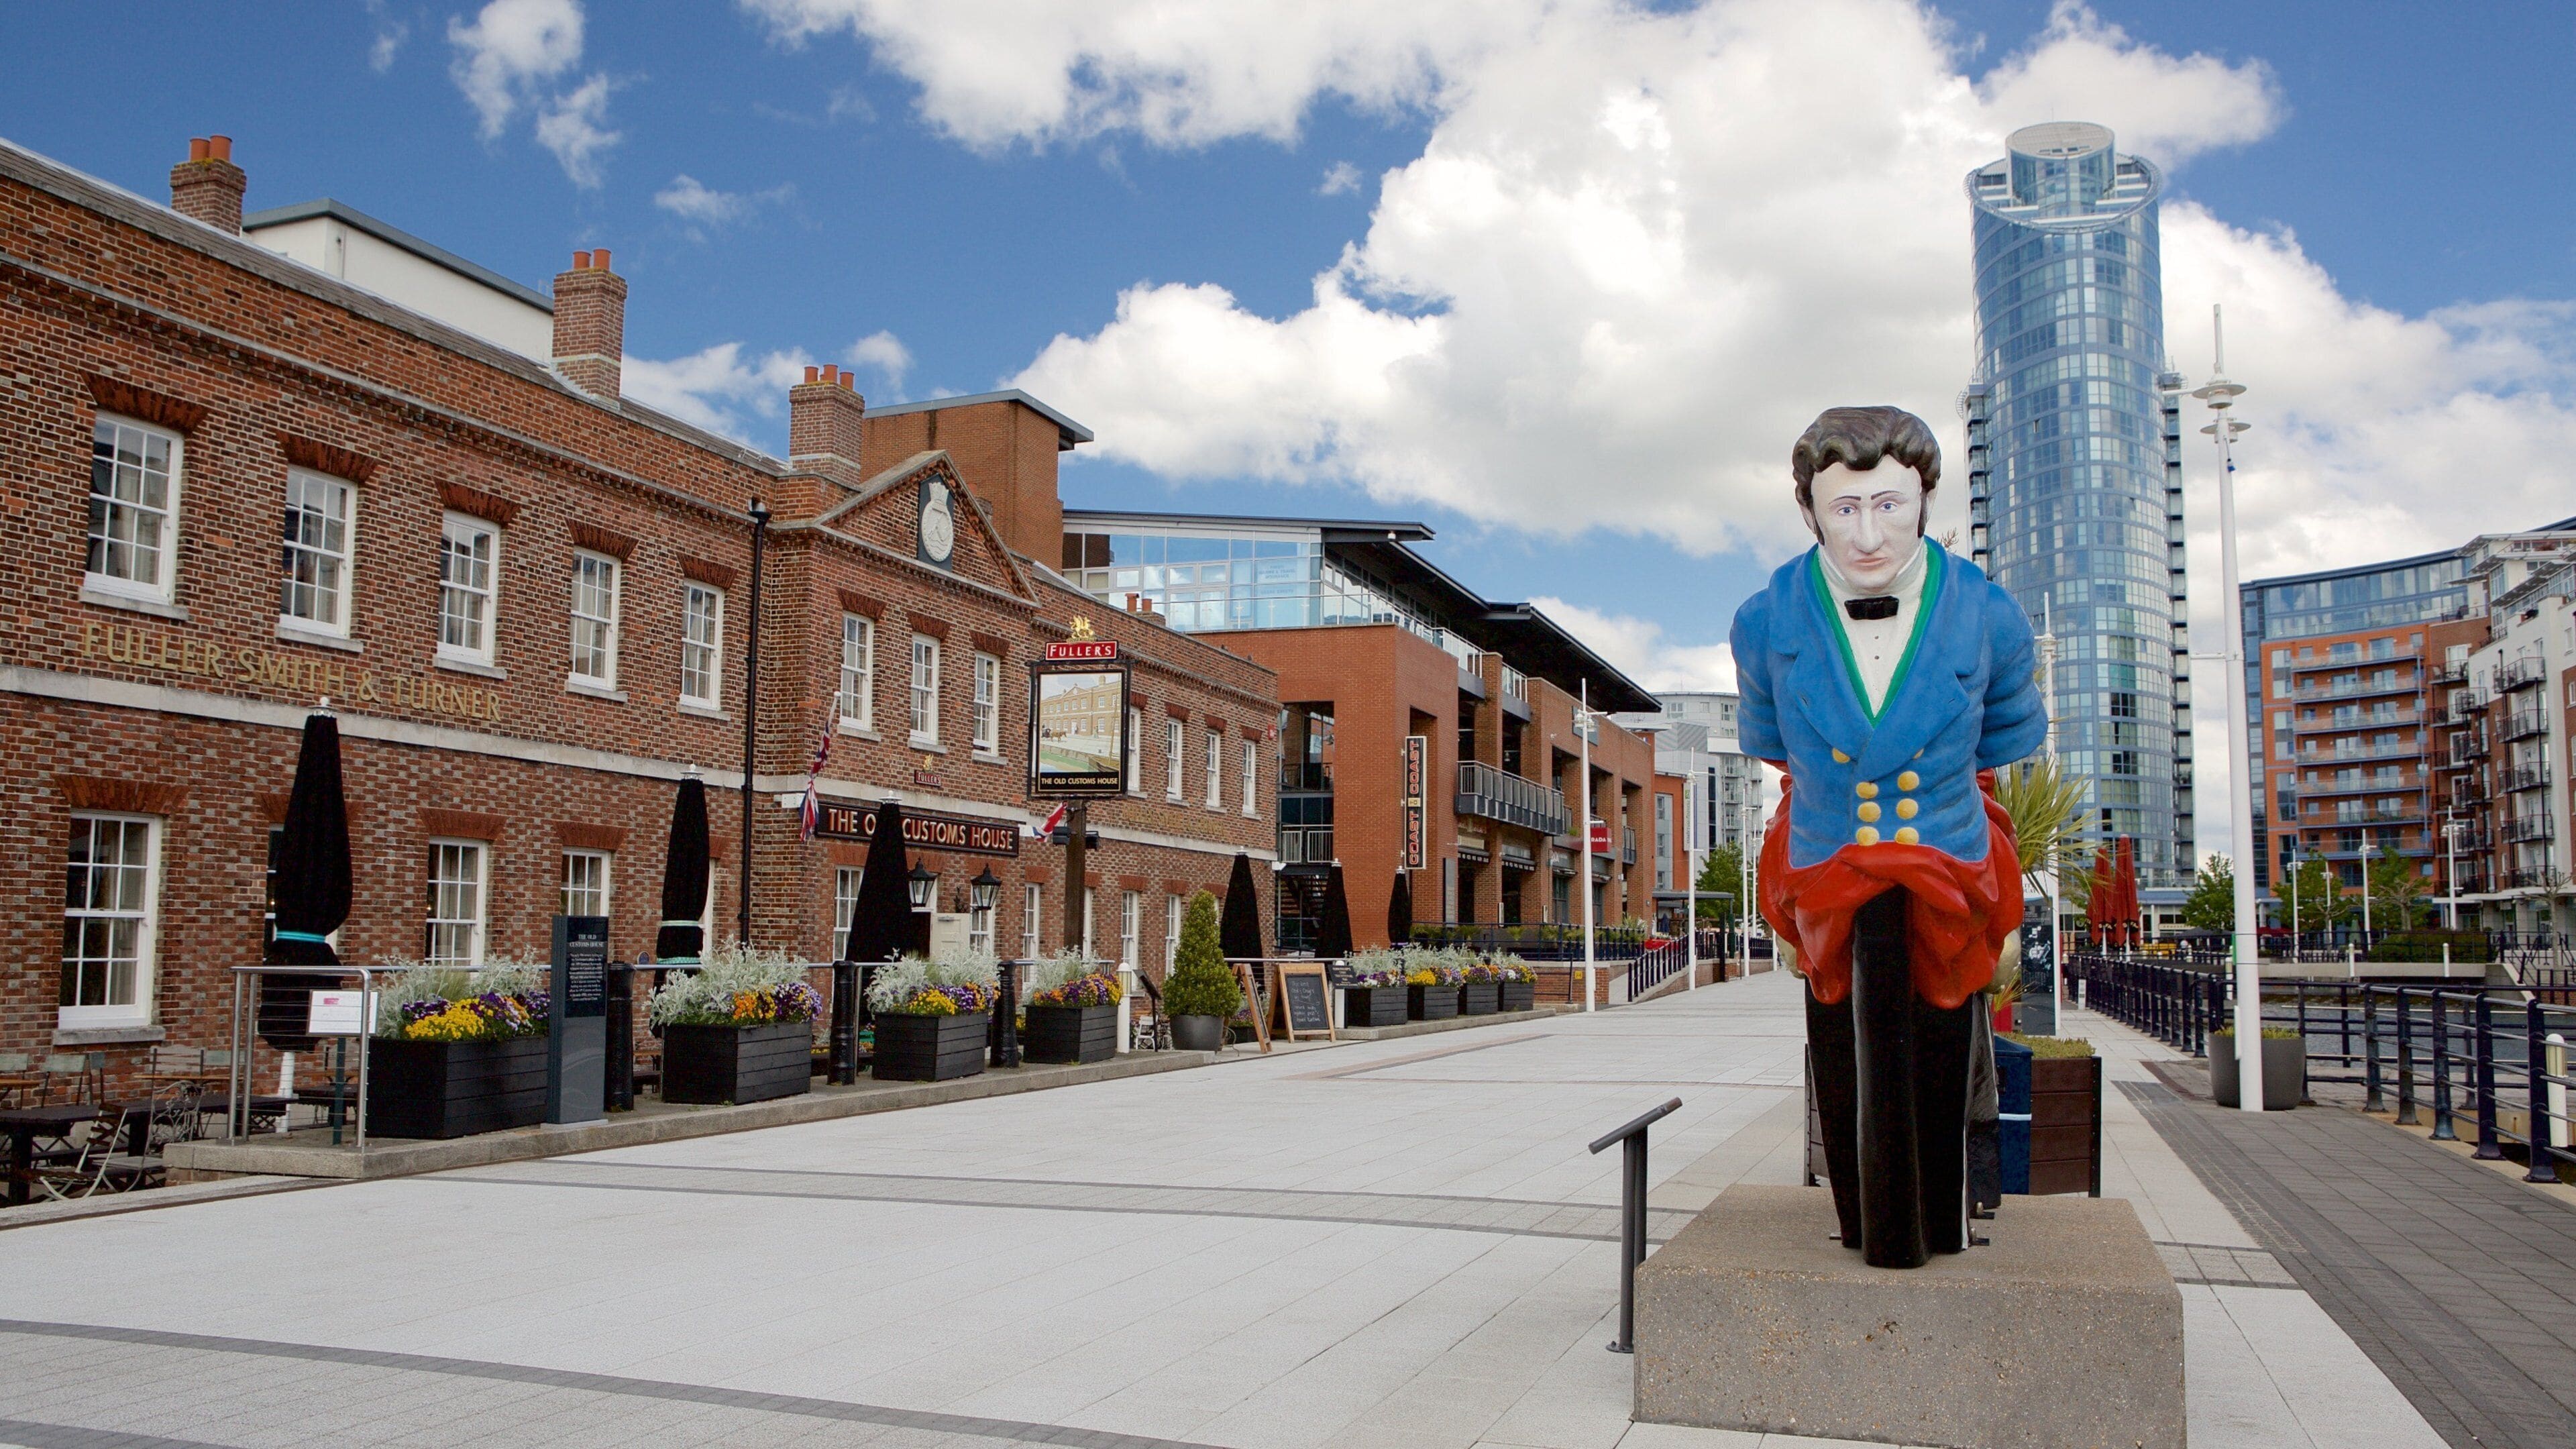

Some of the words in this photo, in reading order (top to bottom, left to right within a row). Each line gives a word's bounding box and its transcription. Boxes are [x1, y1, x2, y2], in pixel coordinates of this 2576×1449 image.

[81, 623, 223, 679] FULLER
[236, 648, 345, 698] SMITH
[359, 670, 382, 704] &
[389, 674, 502, 722] TURNER
[1050, 643, 1112, 657] FULLER'S
[1409, 741, 1419, 794] COAST
[828, 808, 858, 834] THE
[902, 818, 966, 846] CUSTOMS
[971, 826, 1014, 851] HOUSE
[1409, 810, 1419, 865] COAST
